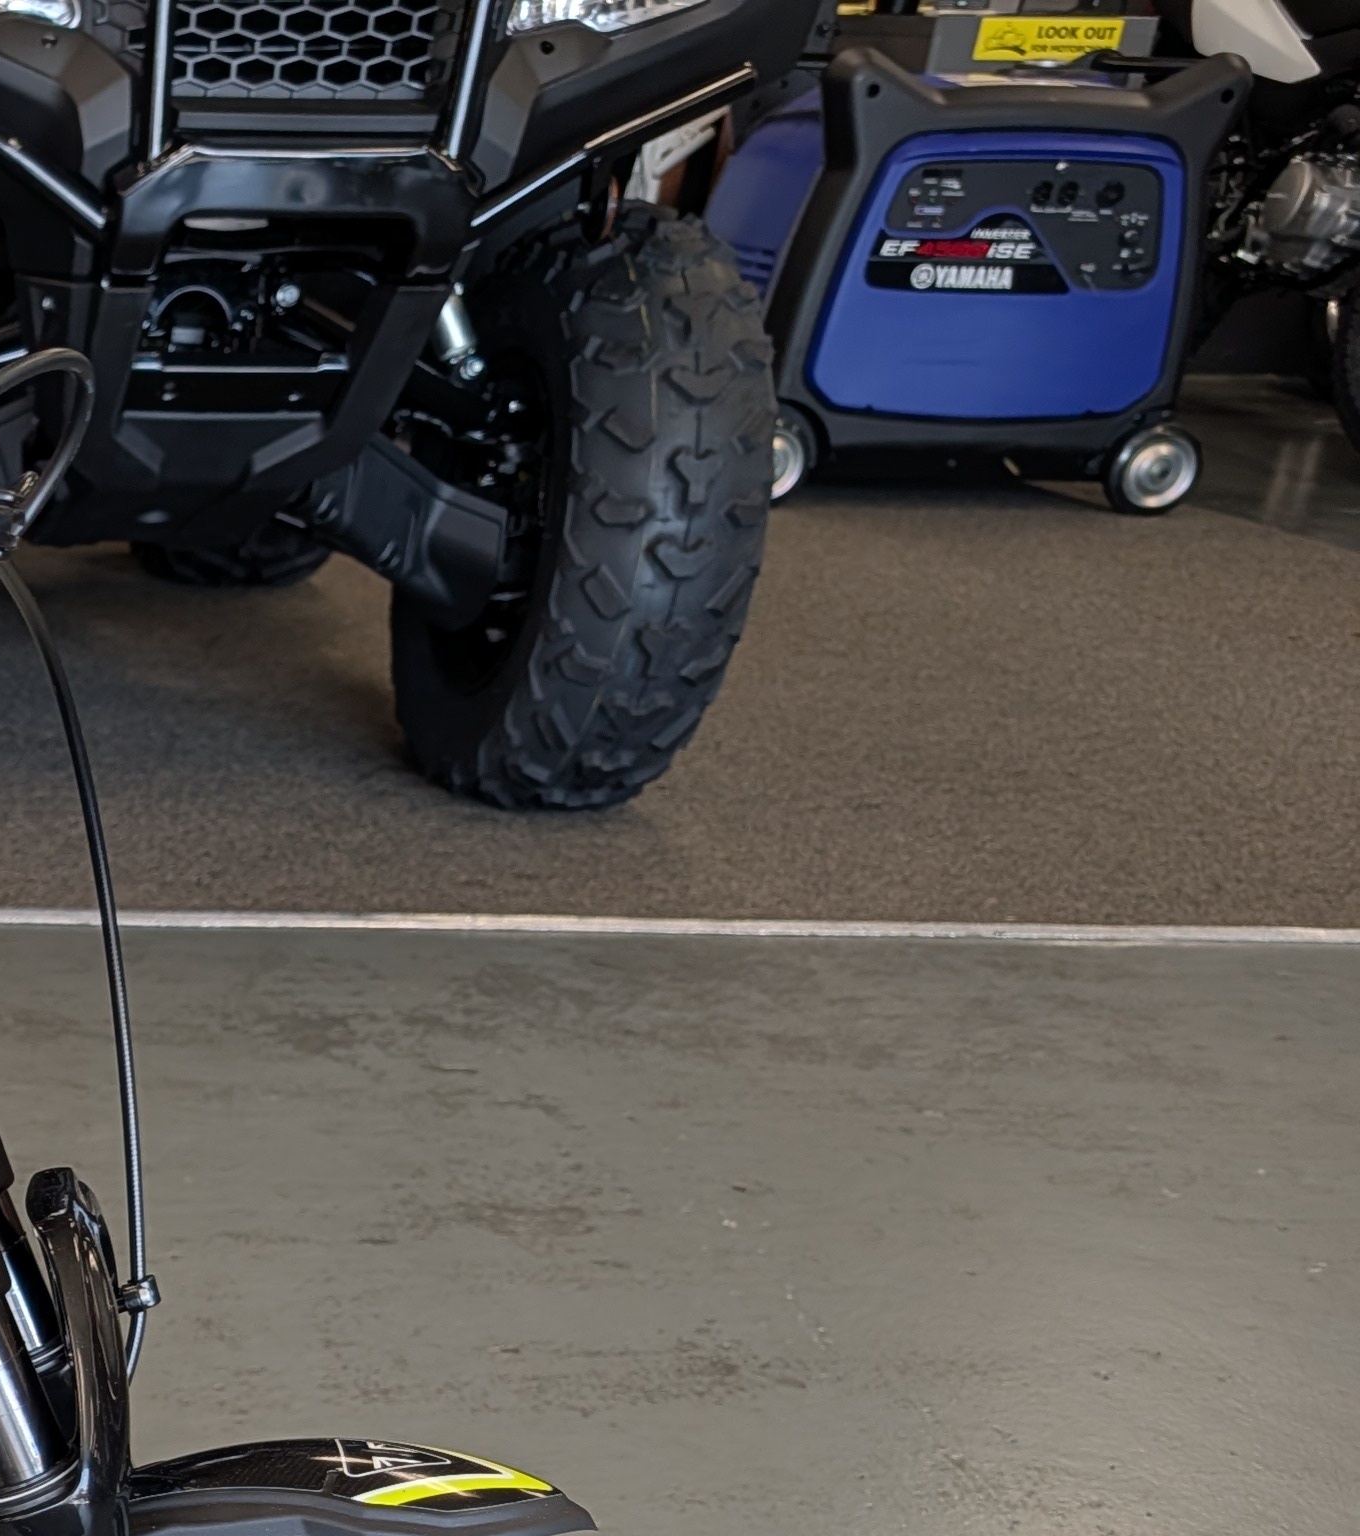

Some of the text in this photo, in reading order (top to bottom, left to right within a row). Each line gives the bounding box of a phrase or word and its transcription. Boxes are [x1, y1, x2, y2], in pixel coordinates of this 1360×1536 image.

[1037, 26, 1118, 40] LOOK OUT
[935, 264, 1014, 290] YAMAHA
